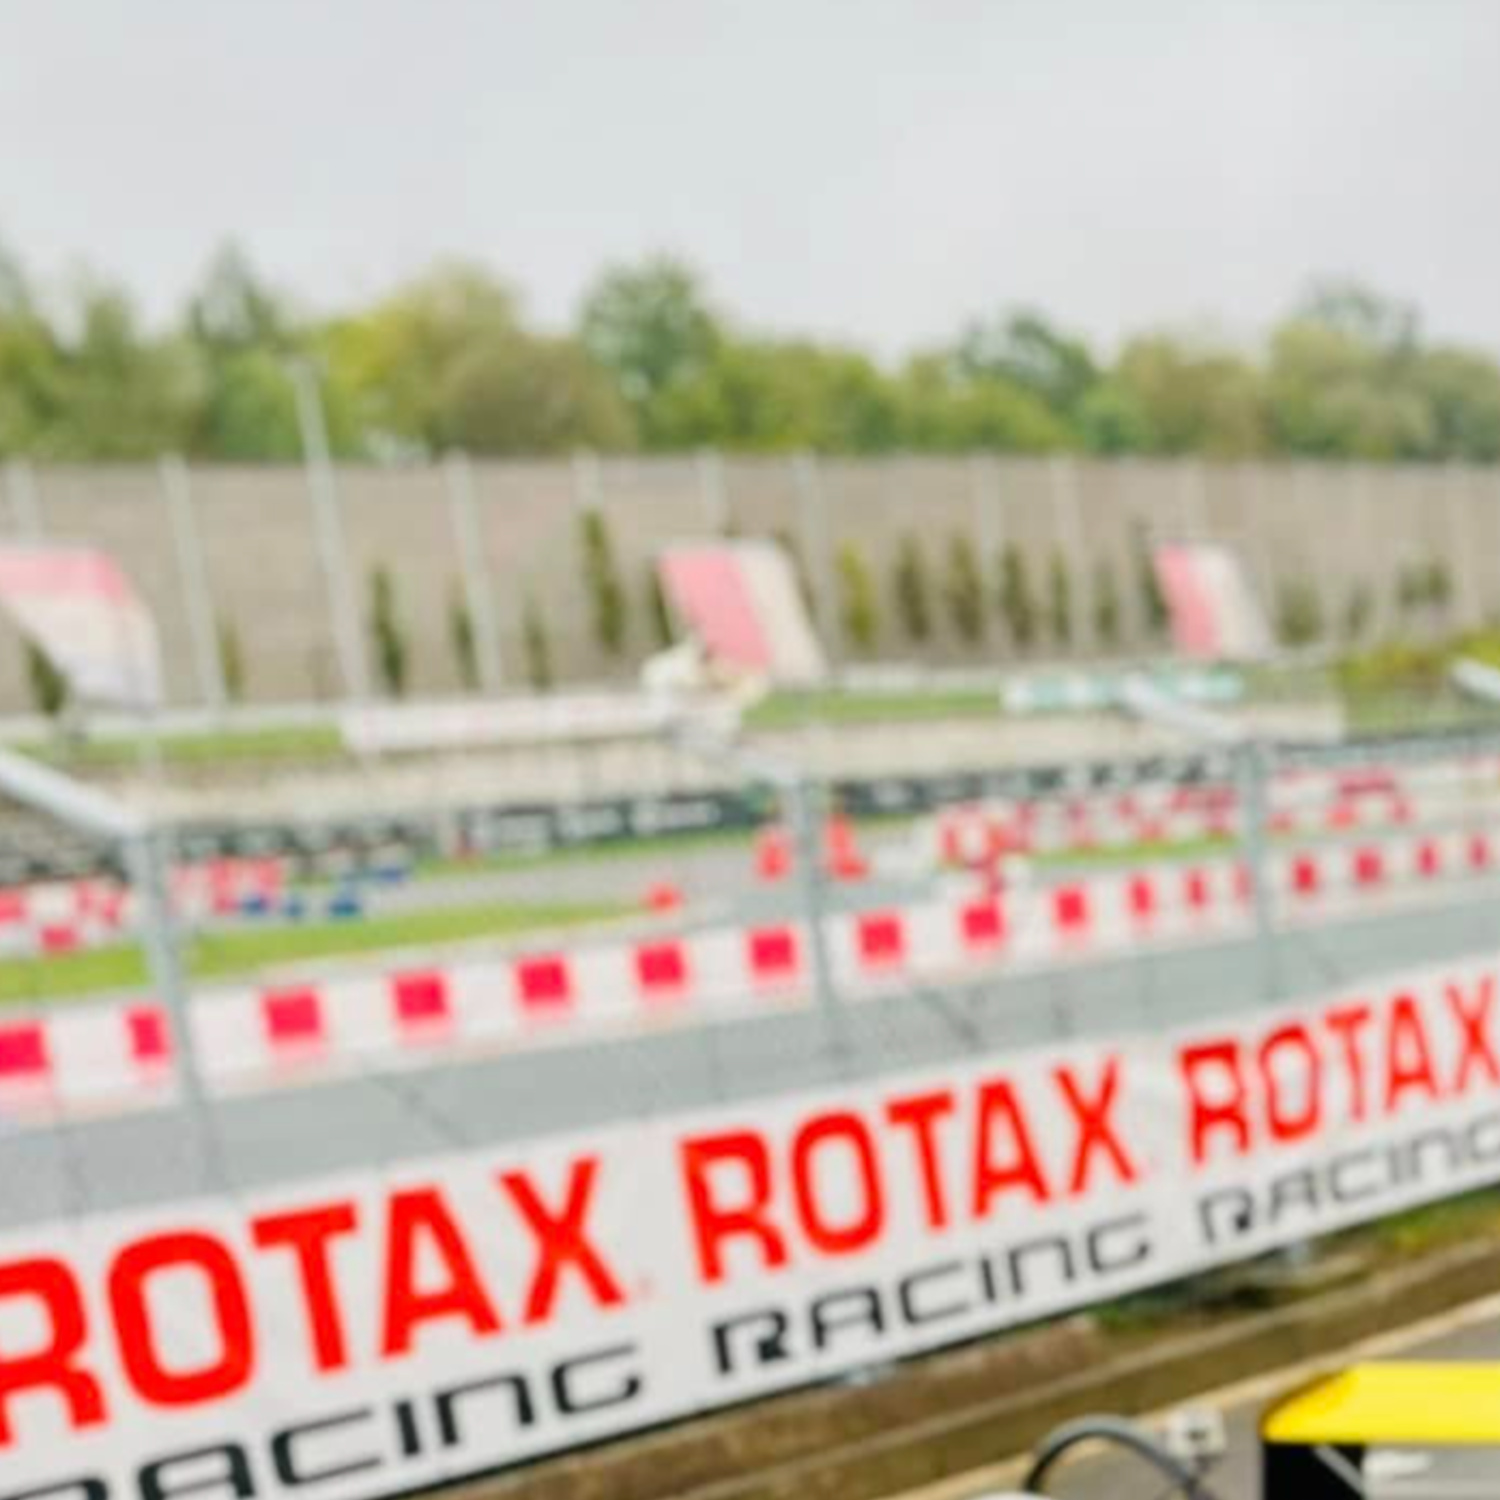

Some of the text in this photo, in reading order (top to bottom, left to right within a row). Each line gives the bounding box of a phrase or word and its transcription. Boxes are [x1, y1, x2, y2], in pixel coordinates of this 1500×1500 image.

[0, 1155, 624, 1447] ROTAX
[678, 1055, 1136, 1284] ROTAX
[711, 1212, 1151, 1375] RACING
